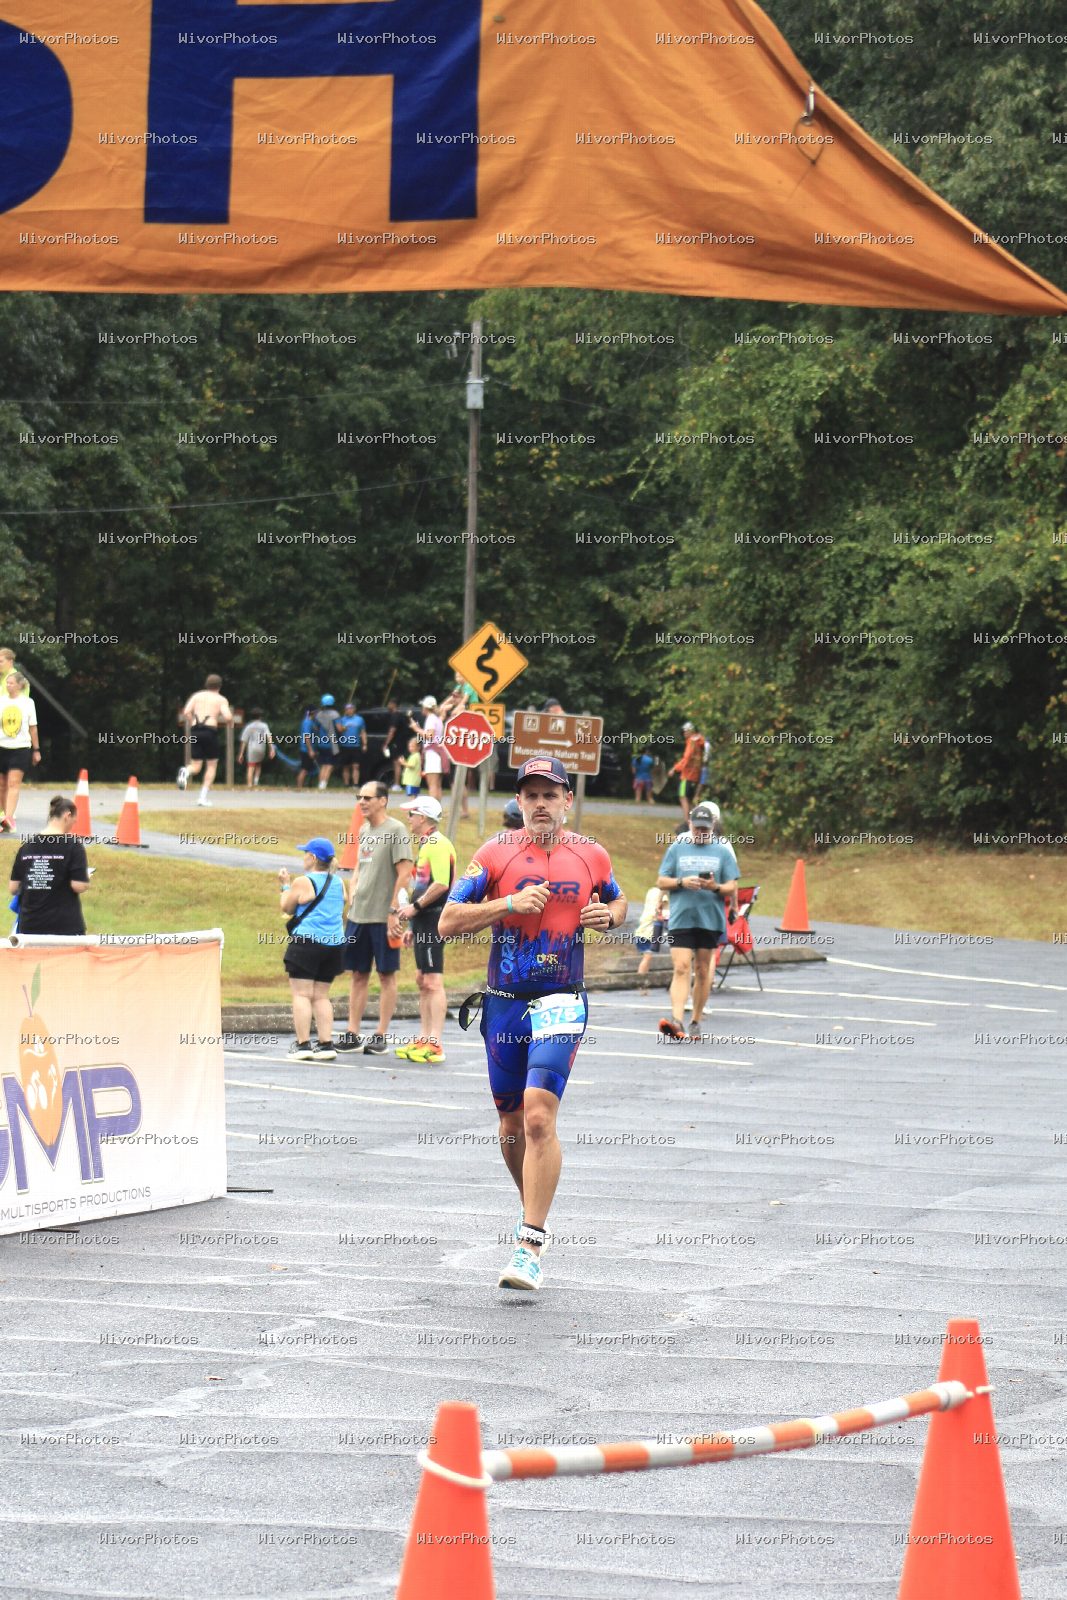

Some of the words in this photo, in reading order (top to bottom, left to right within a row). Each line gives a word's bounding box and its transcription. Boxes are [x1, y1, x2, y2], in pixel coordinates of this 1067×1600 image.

[0, 0, 482, 224] H
[474, 707, 500, 725] 5
[448, 725, 491, 751] STOP
[514, 746, 553, 757] Muscadine
[554, 750, 579, 760] Nature
[580, 752, 596, 761] Trail
[540, 1007, 577, 1027] 375
[0, 1062, 142, 1194] MP
[0, 1197, 77, 1220] MULTISPORTS
[79, 1186, 152, 1208] PRODUCTIONS
